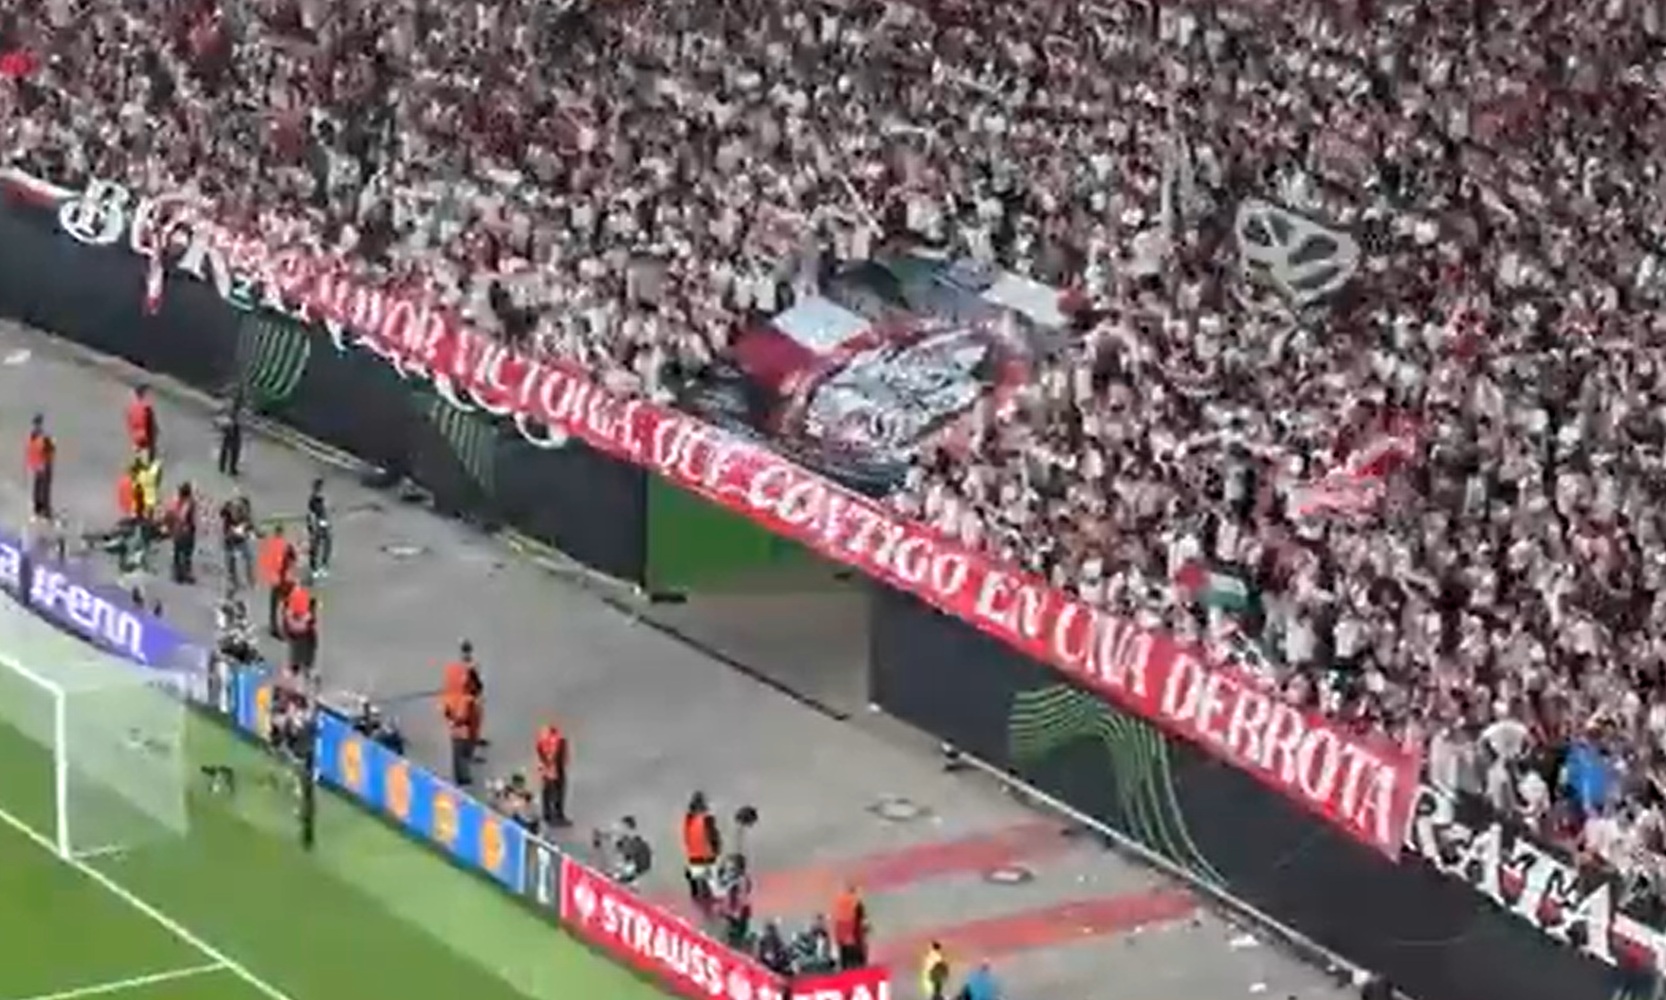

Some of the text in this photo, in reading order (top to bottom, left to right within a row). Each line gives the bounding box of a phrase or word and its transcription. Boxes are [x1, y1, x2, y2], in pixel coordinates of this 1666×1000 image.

[974, 569, 1049, 637] EN
[1160, 651, 1397, 844] DERROTA
[601, 893, 724, 996] STRAUSS
